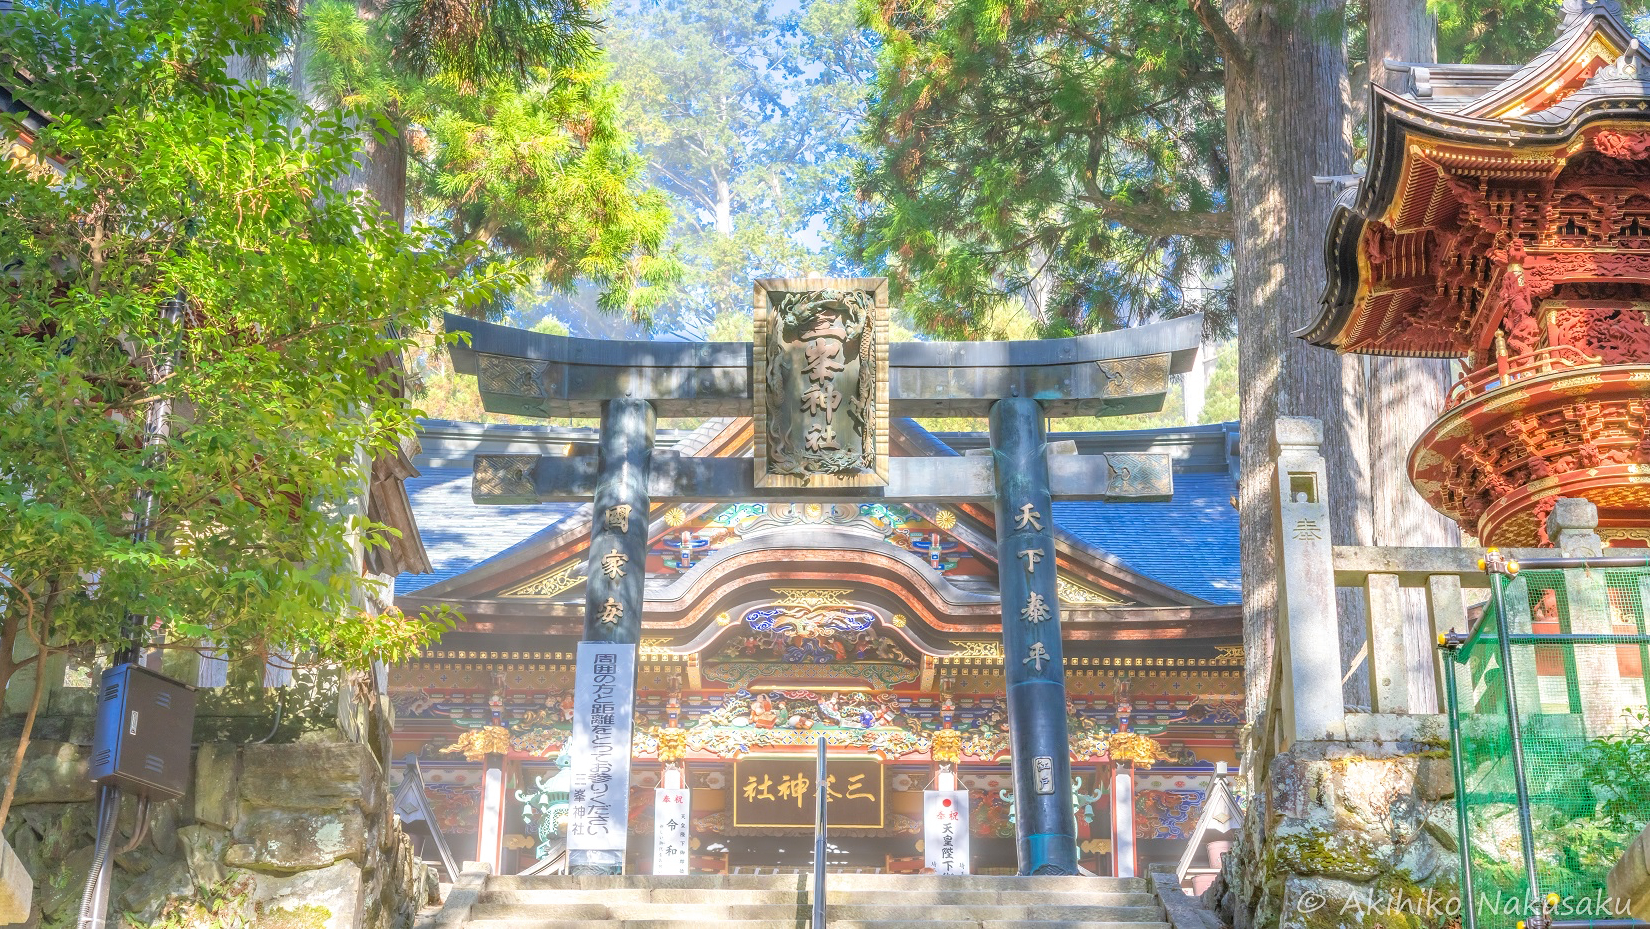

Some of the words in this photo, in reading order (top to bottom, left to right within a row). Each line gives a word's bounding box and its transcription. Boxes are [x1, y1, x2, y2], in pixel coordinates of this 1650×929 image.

[1292, 517, 1322, 543] 奉
[1014, 502, 1053, 672] 天下泰平
[571, 773, 587, 836] 三峯神社
[665, 818, 679, 857] 令和
[941, 822, 955, 875] 天皇陛下
